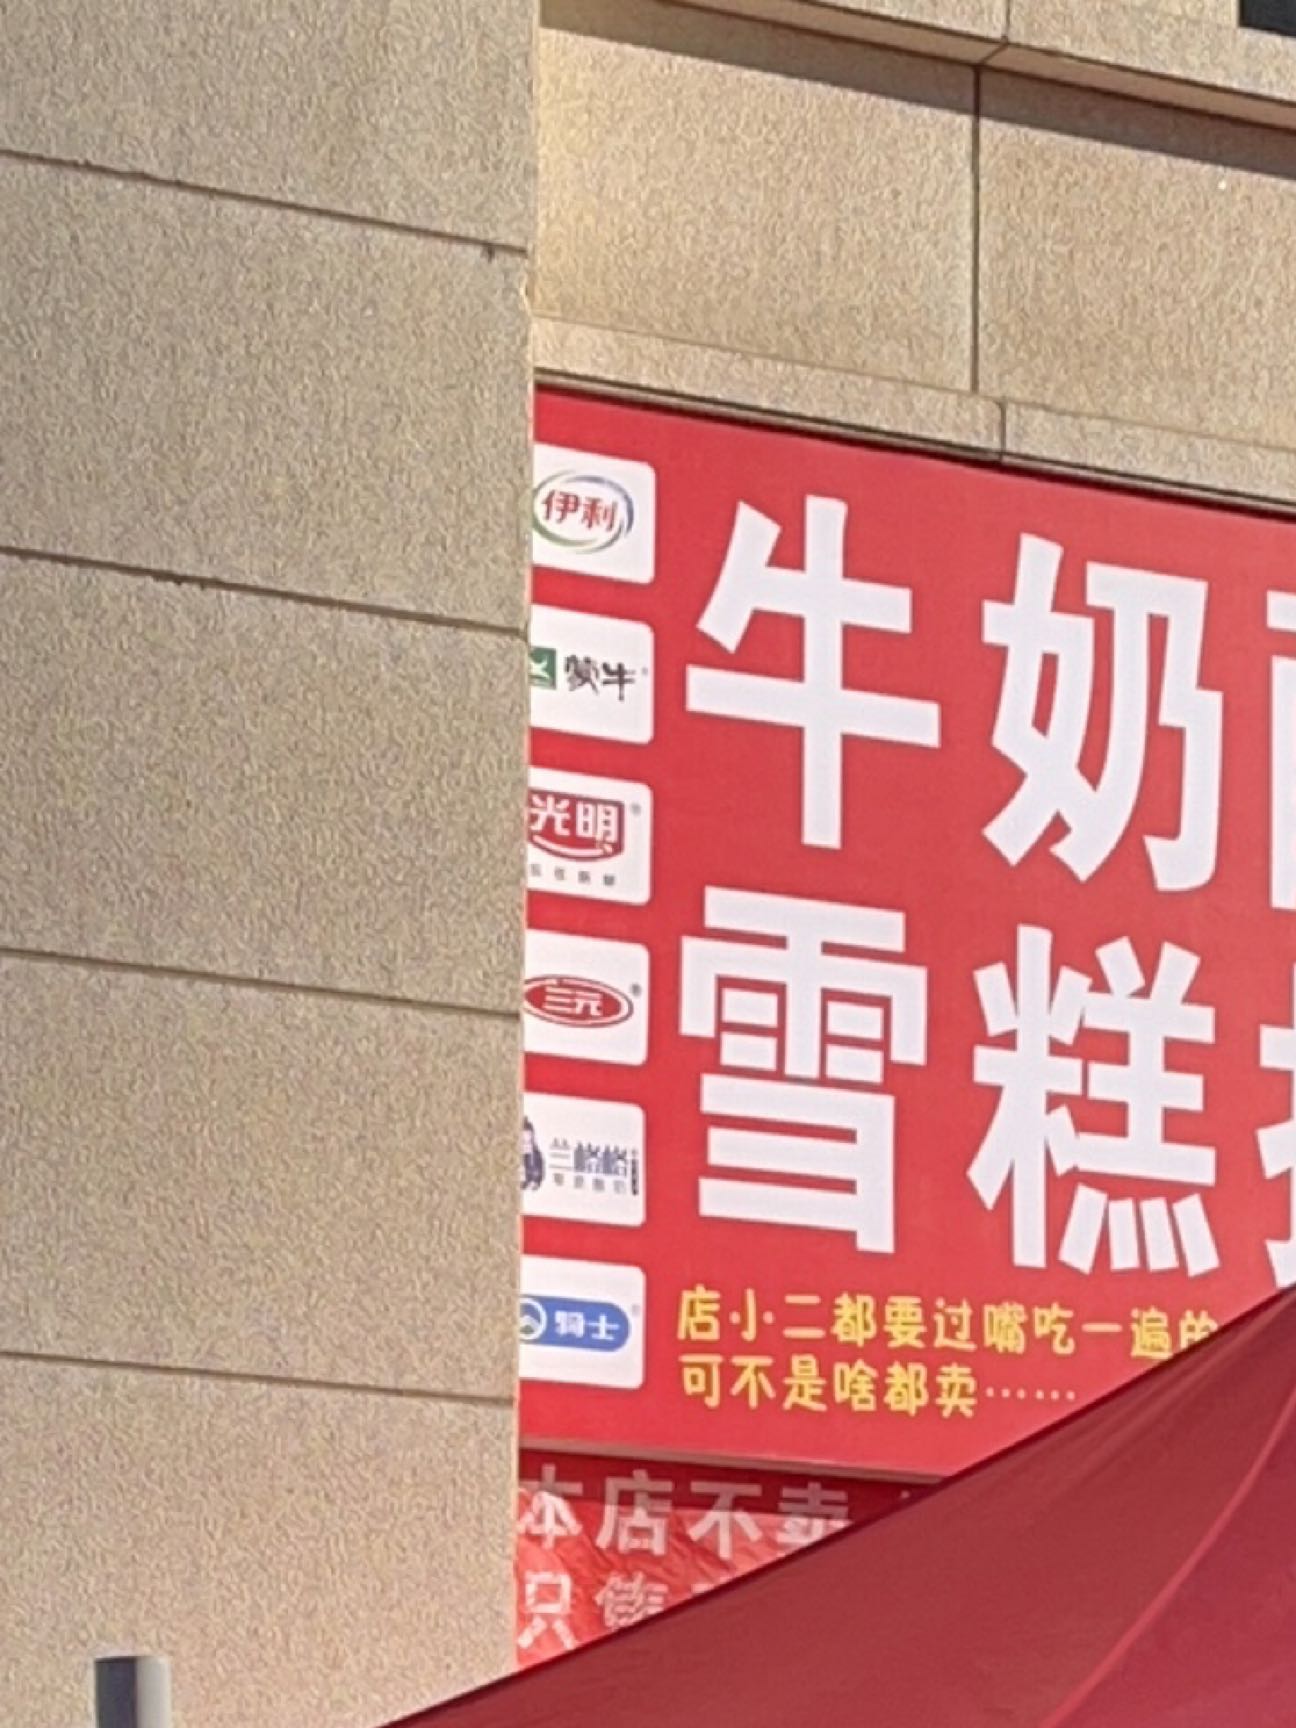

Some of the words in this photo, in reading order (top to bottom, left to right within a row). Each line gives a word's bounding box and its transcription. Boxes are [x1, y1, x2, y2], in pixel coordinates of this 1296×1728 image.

[541, 488, 619, 532] 伊利
[529, 793, 620, 853] 光明
[518, 1463, 911, 1561] 本店不卖
